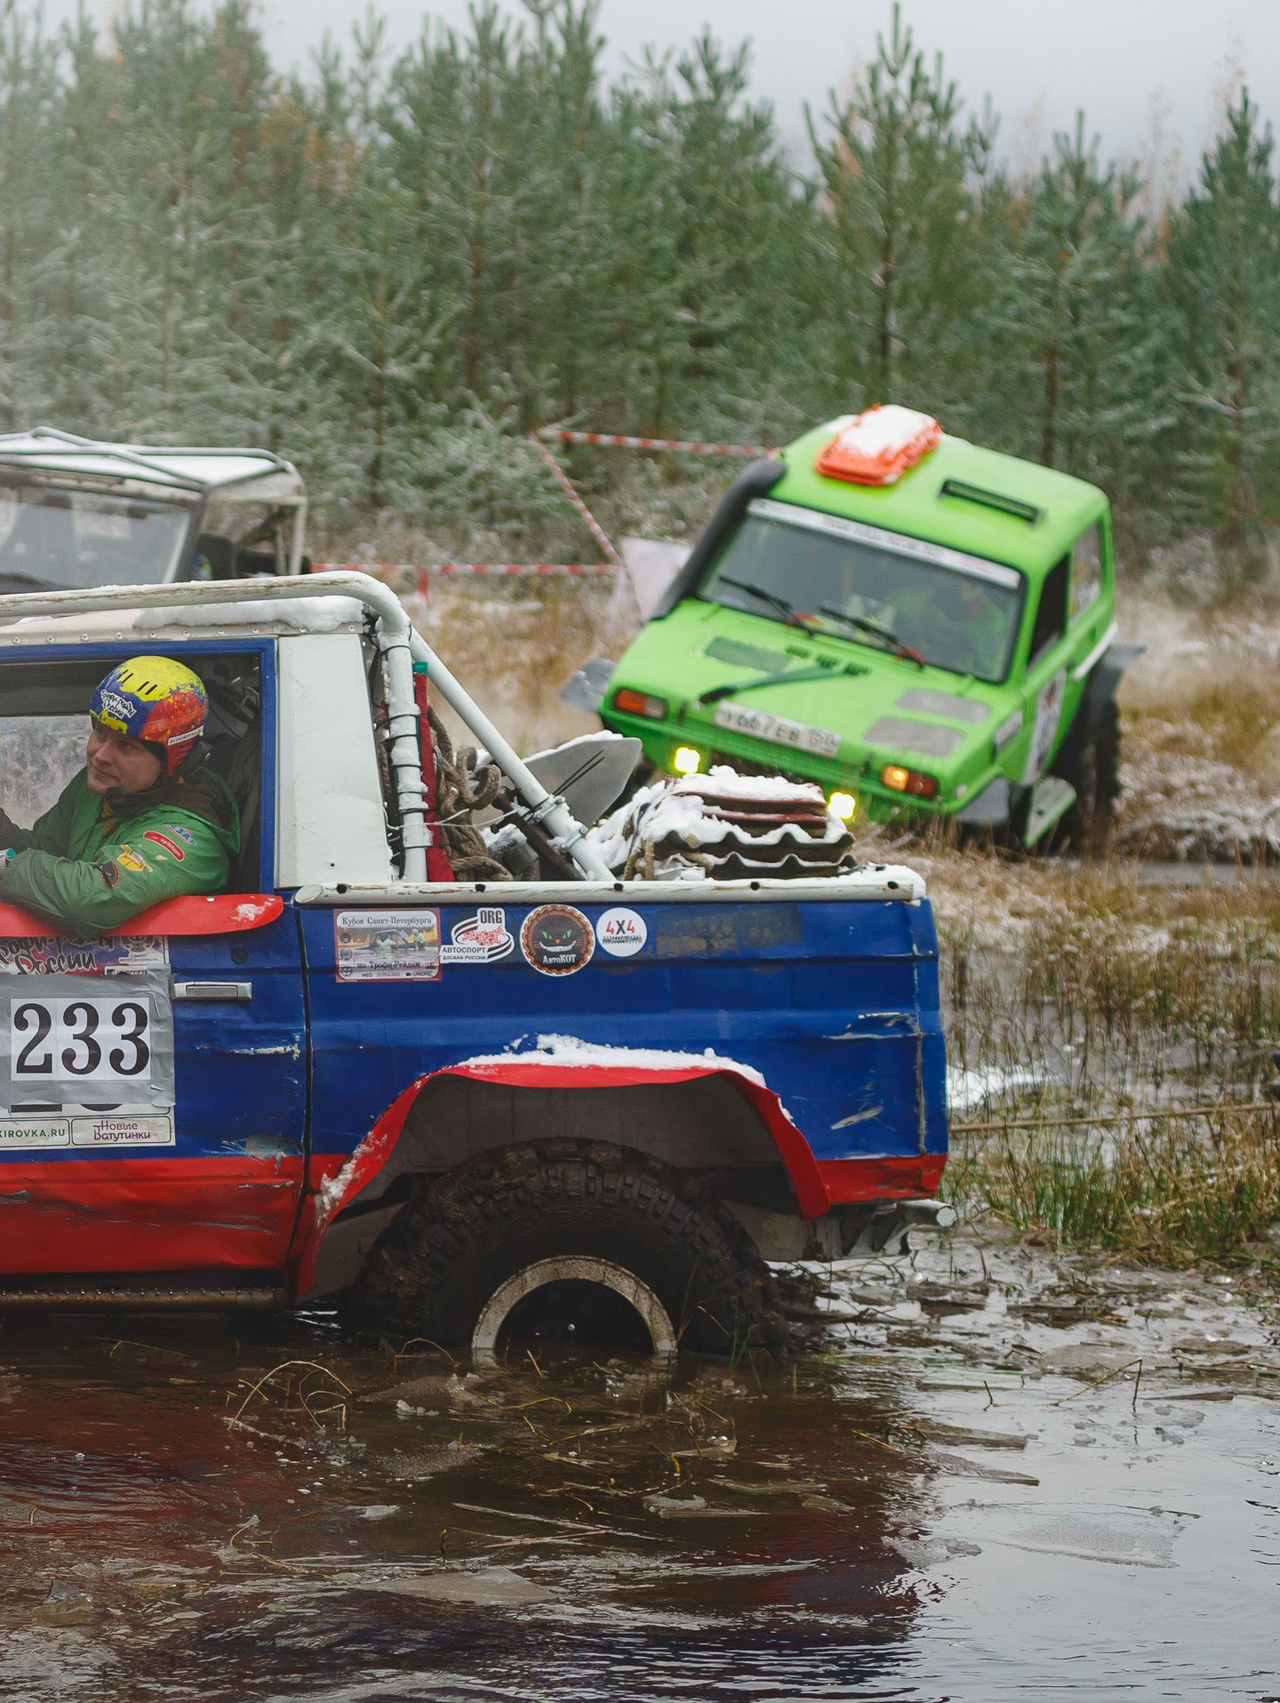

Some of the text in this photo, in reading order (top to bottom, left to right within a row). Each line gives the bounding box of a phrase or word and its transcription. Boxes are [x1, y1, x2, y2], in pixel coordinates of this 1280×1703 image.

[342, 917, 364, 926] Кубок
[480, 910, 502, 924] ORG
[606, 920, 635, 935] 4X4
[442, 946, 486, 954] АВТОСПОРТ
[14, 1002, 150, 1075] 233
[93, 1120, 138, 1131] Новые
